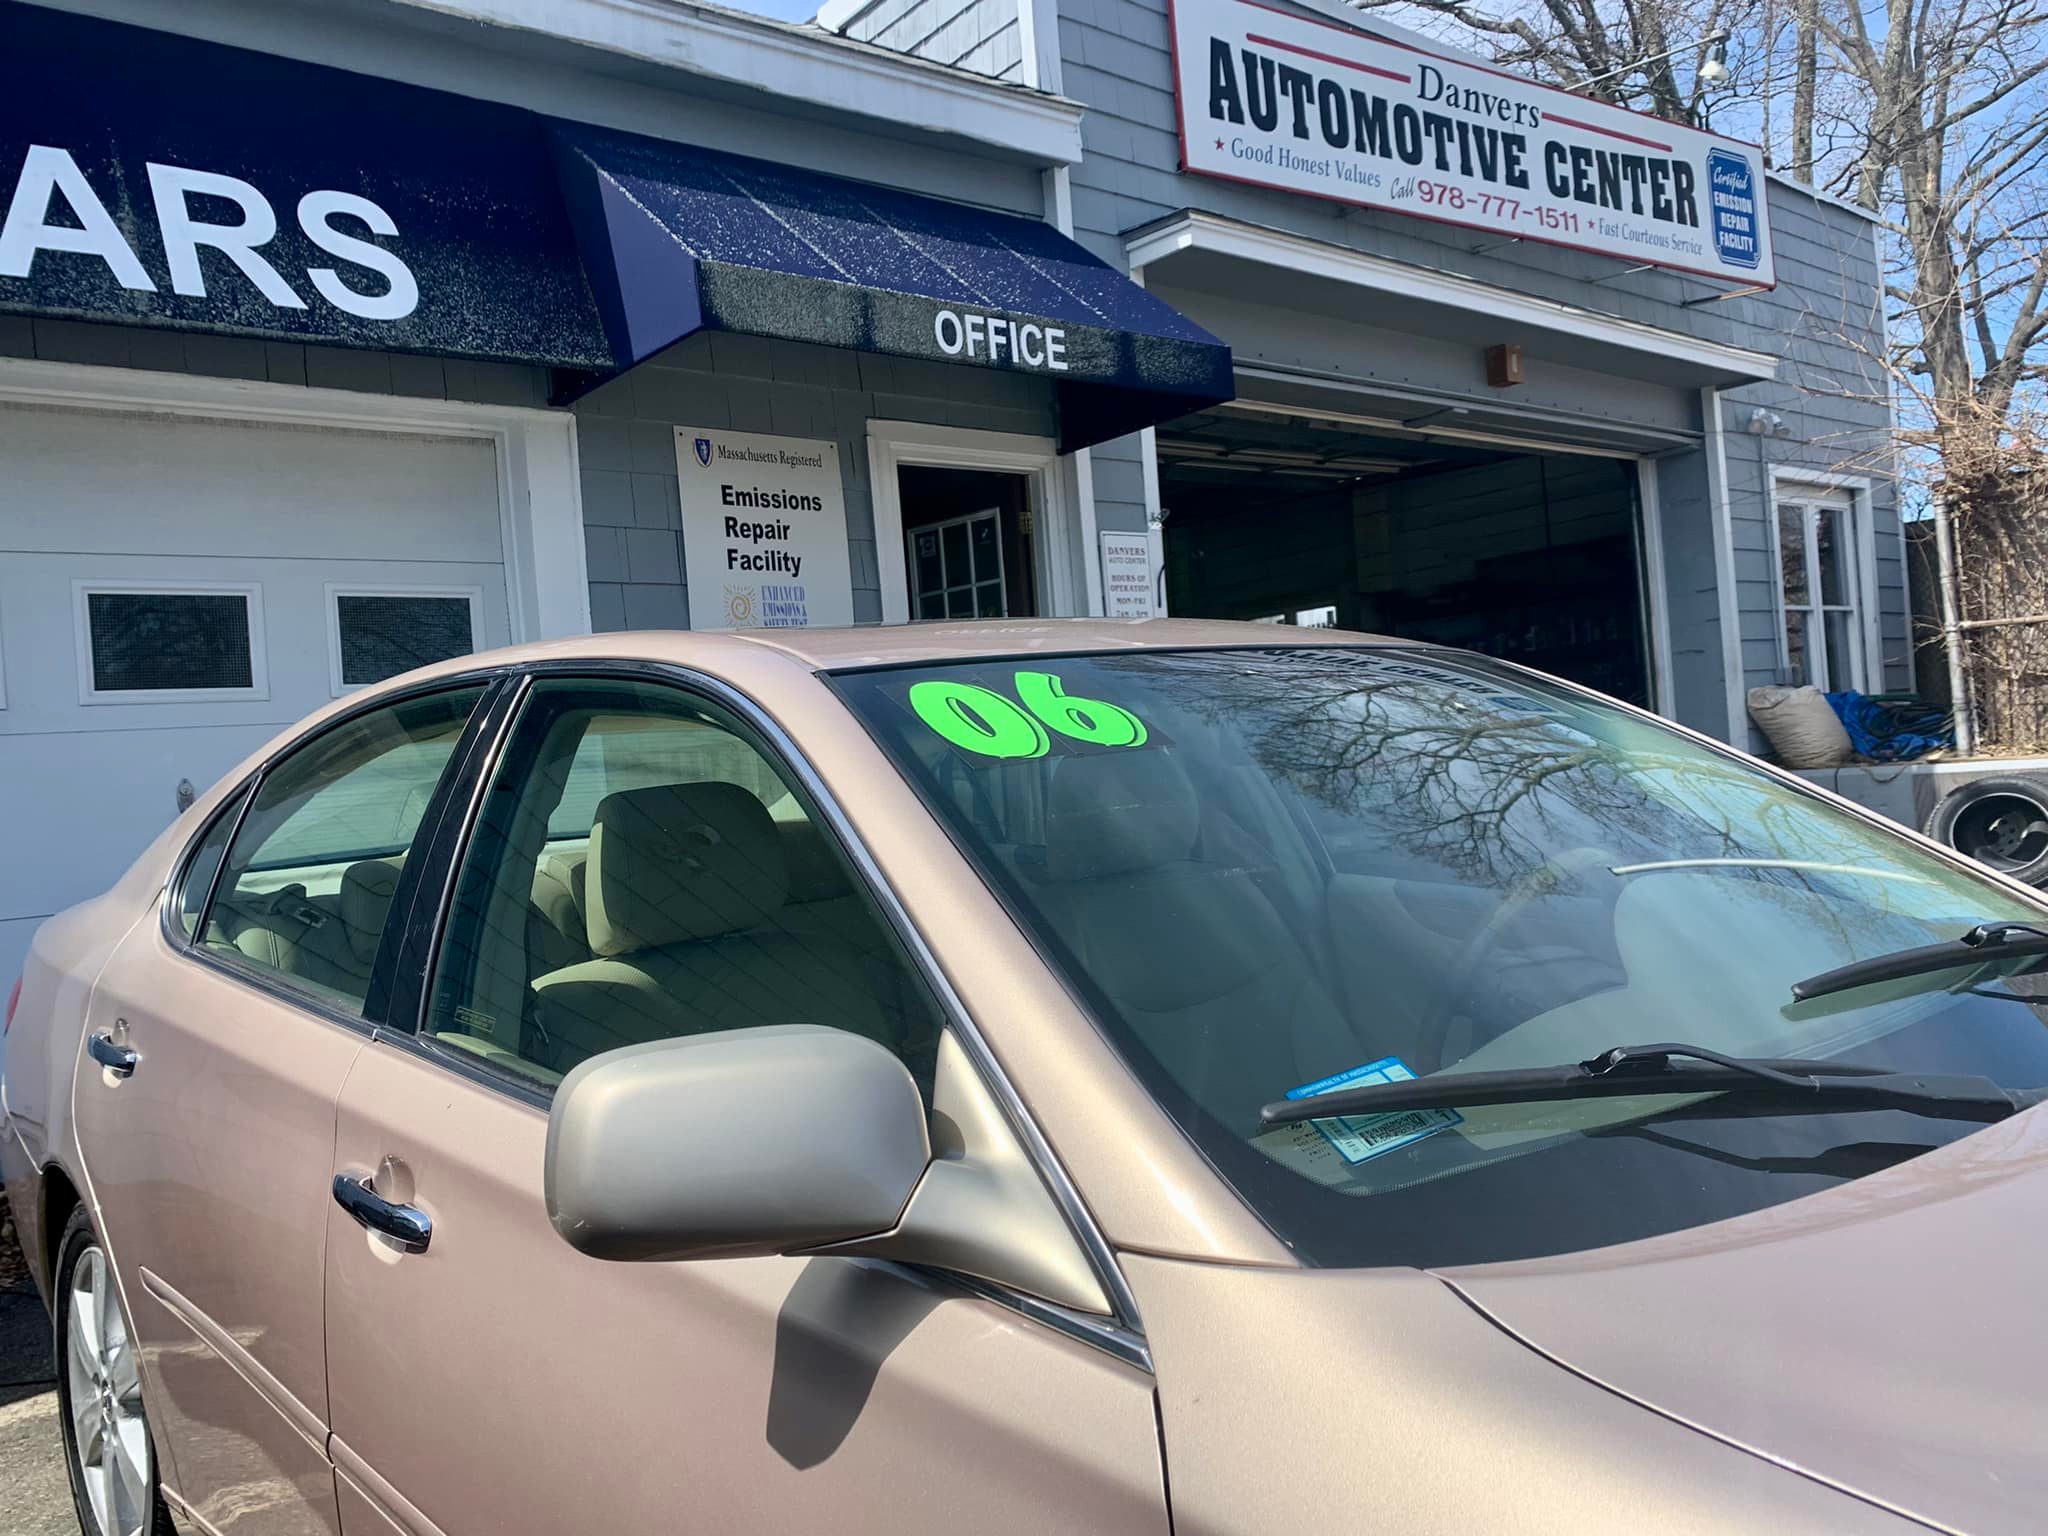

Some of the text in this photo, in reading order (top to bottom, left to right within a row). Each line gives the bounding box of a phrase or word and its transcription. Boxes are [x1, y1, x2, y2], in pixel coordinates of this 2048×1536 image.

[1417, 64, 1540, 129] Danvers
[1208, 36, 1699, 228] AUTOMOTIVE CENTER
[1231, 137, 1382, 188] Good Honest Values
[1713, 166, 1748, 193] Certified
[1390, 176, 1579, 233] Call 978-777-1511
[1713, 190, 1753, 214] EMISSION
[0, 144, 419, 320] ARS
[1720, 211, 1750, 232] REPAIR
[1598, 217, 1703, 256] Fast Courteous Service
[1719, 230, 1753, 252] FACILITY
[934, 310, 1068, 370] OFFICE
[717, 444, 823, 469] Massachusetts Registered
[721, 484, 823, 511] Emissions
[724, 516, 790, 544] Repair
[727, 548, 802, 577] Facility
[1108, 547, 1145, 555] DANVERS
[908, 671, 1149, 760] 06
